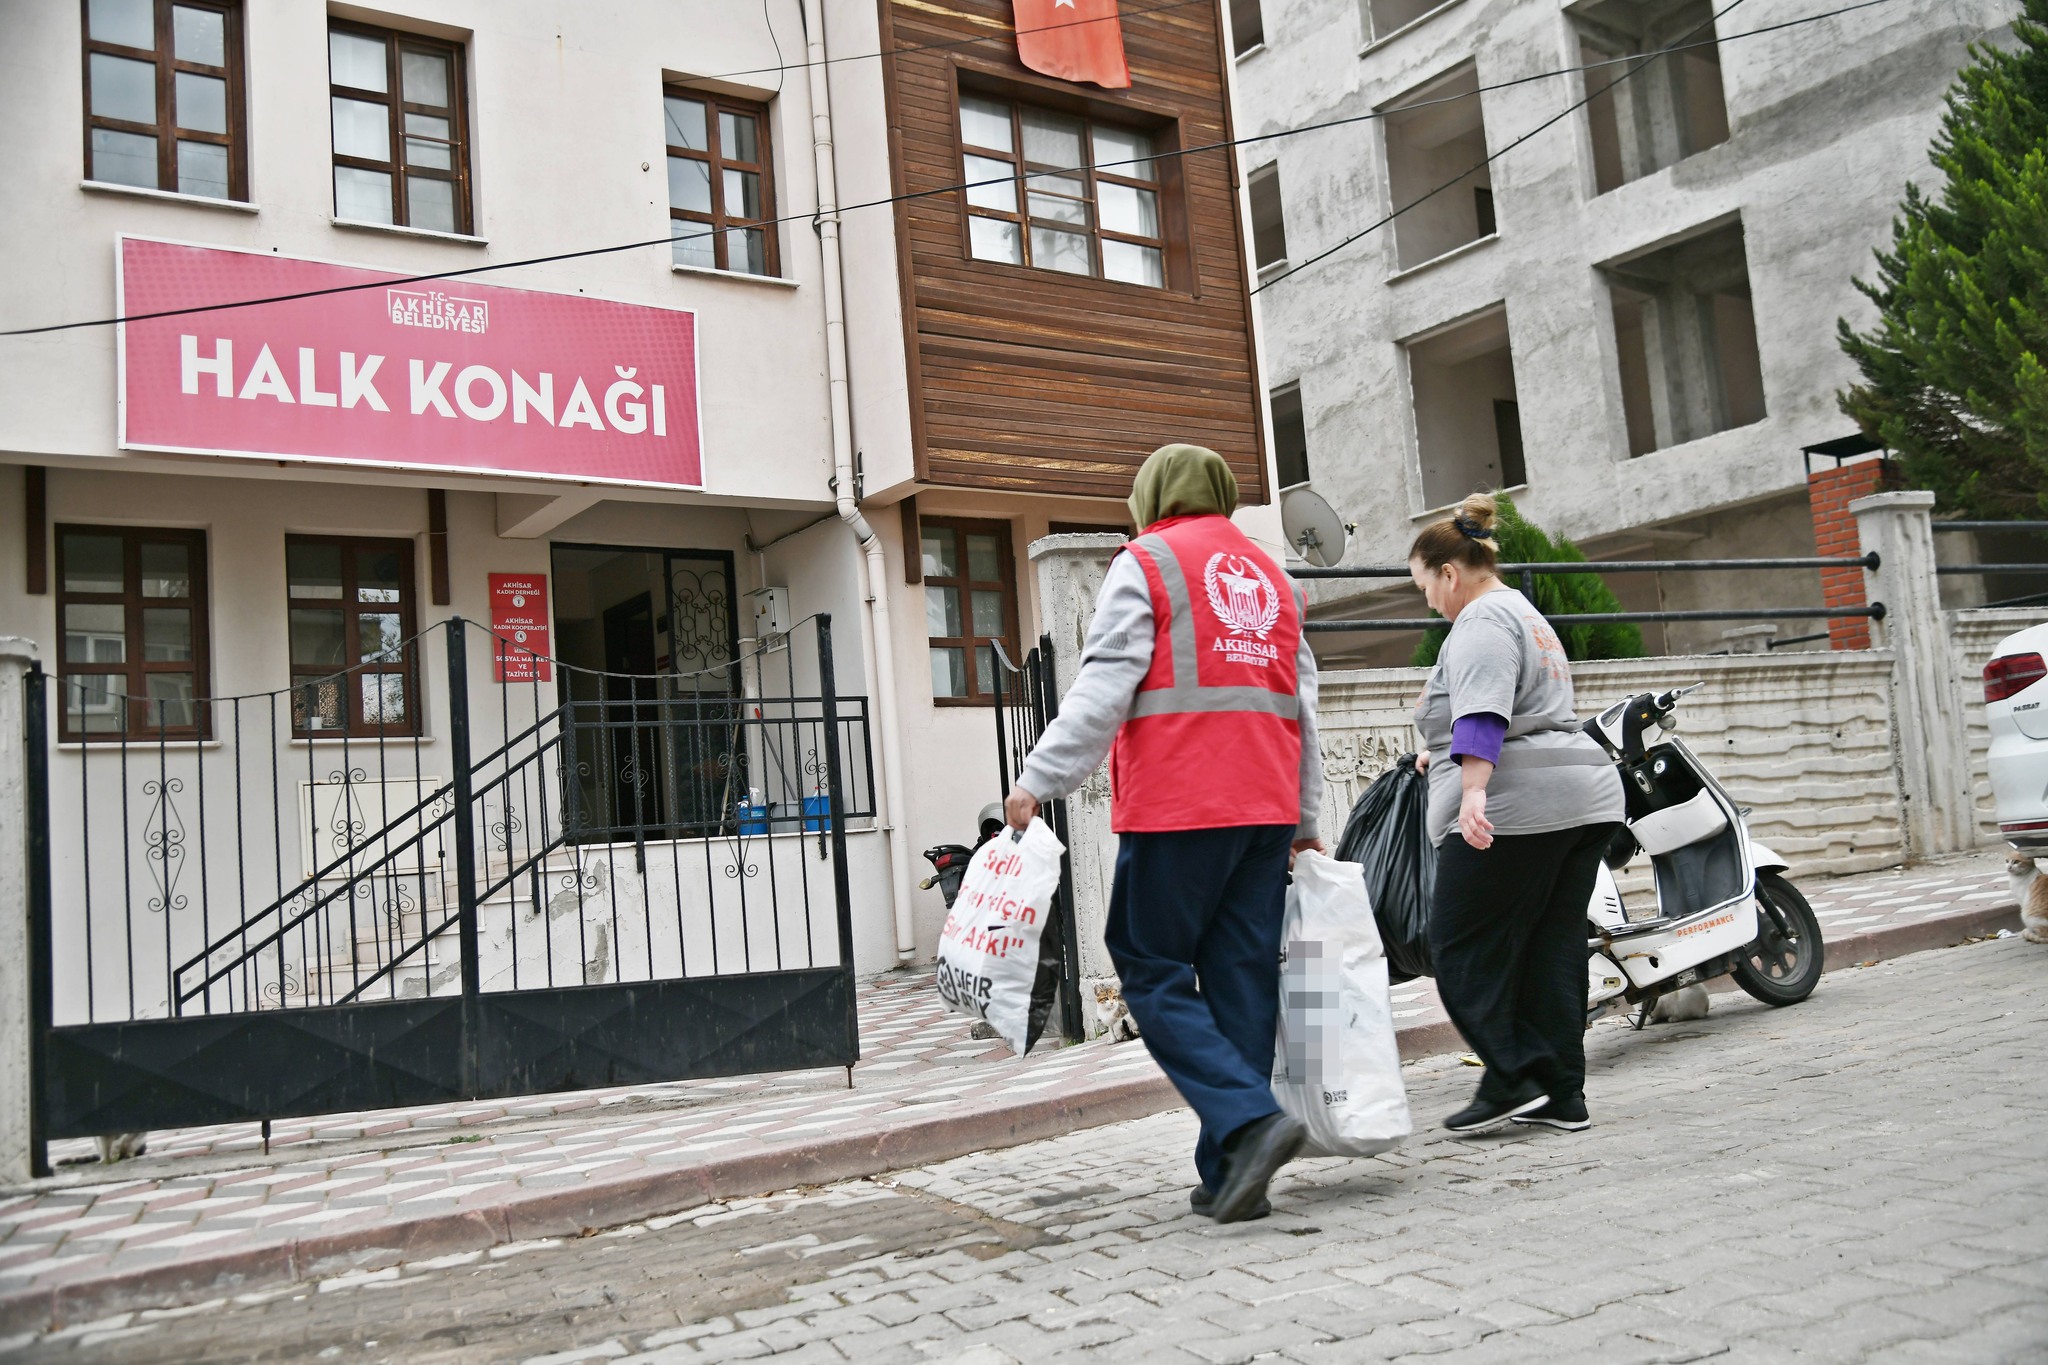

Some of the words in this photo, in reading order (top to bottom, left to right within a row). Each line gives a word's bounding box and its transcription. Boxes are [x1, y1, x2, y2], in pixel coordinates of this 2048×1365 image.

[429, 291, 448, 302] T.C.
[392, 297, 485, 320] AKHİSAR
[392, 309, 486, 334] BELEDİYESİ
[180, 334, 391, 412] HALK
[409, 359, 667, 437] KONAĞI
[1212, 636, 1279, 660] AKHİSAR
[2013, 702, 2040, 712] PASSAT
[1676, 914, 1735, 937] PERFORMANCE
[954, 967, 993, 1000] SIFIR
